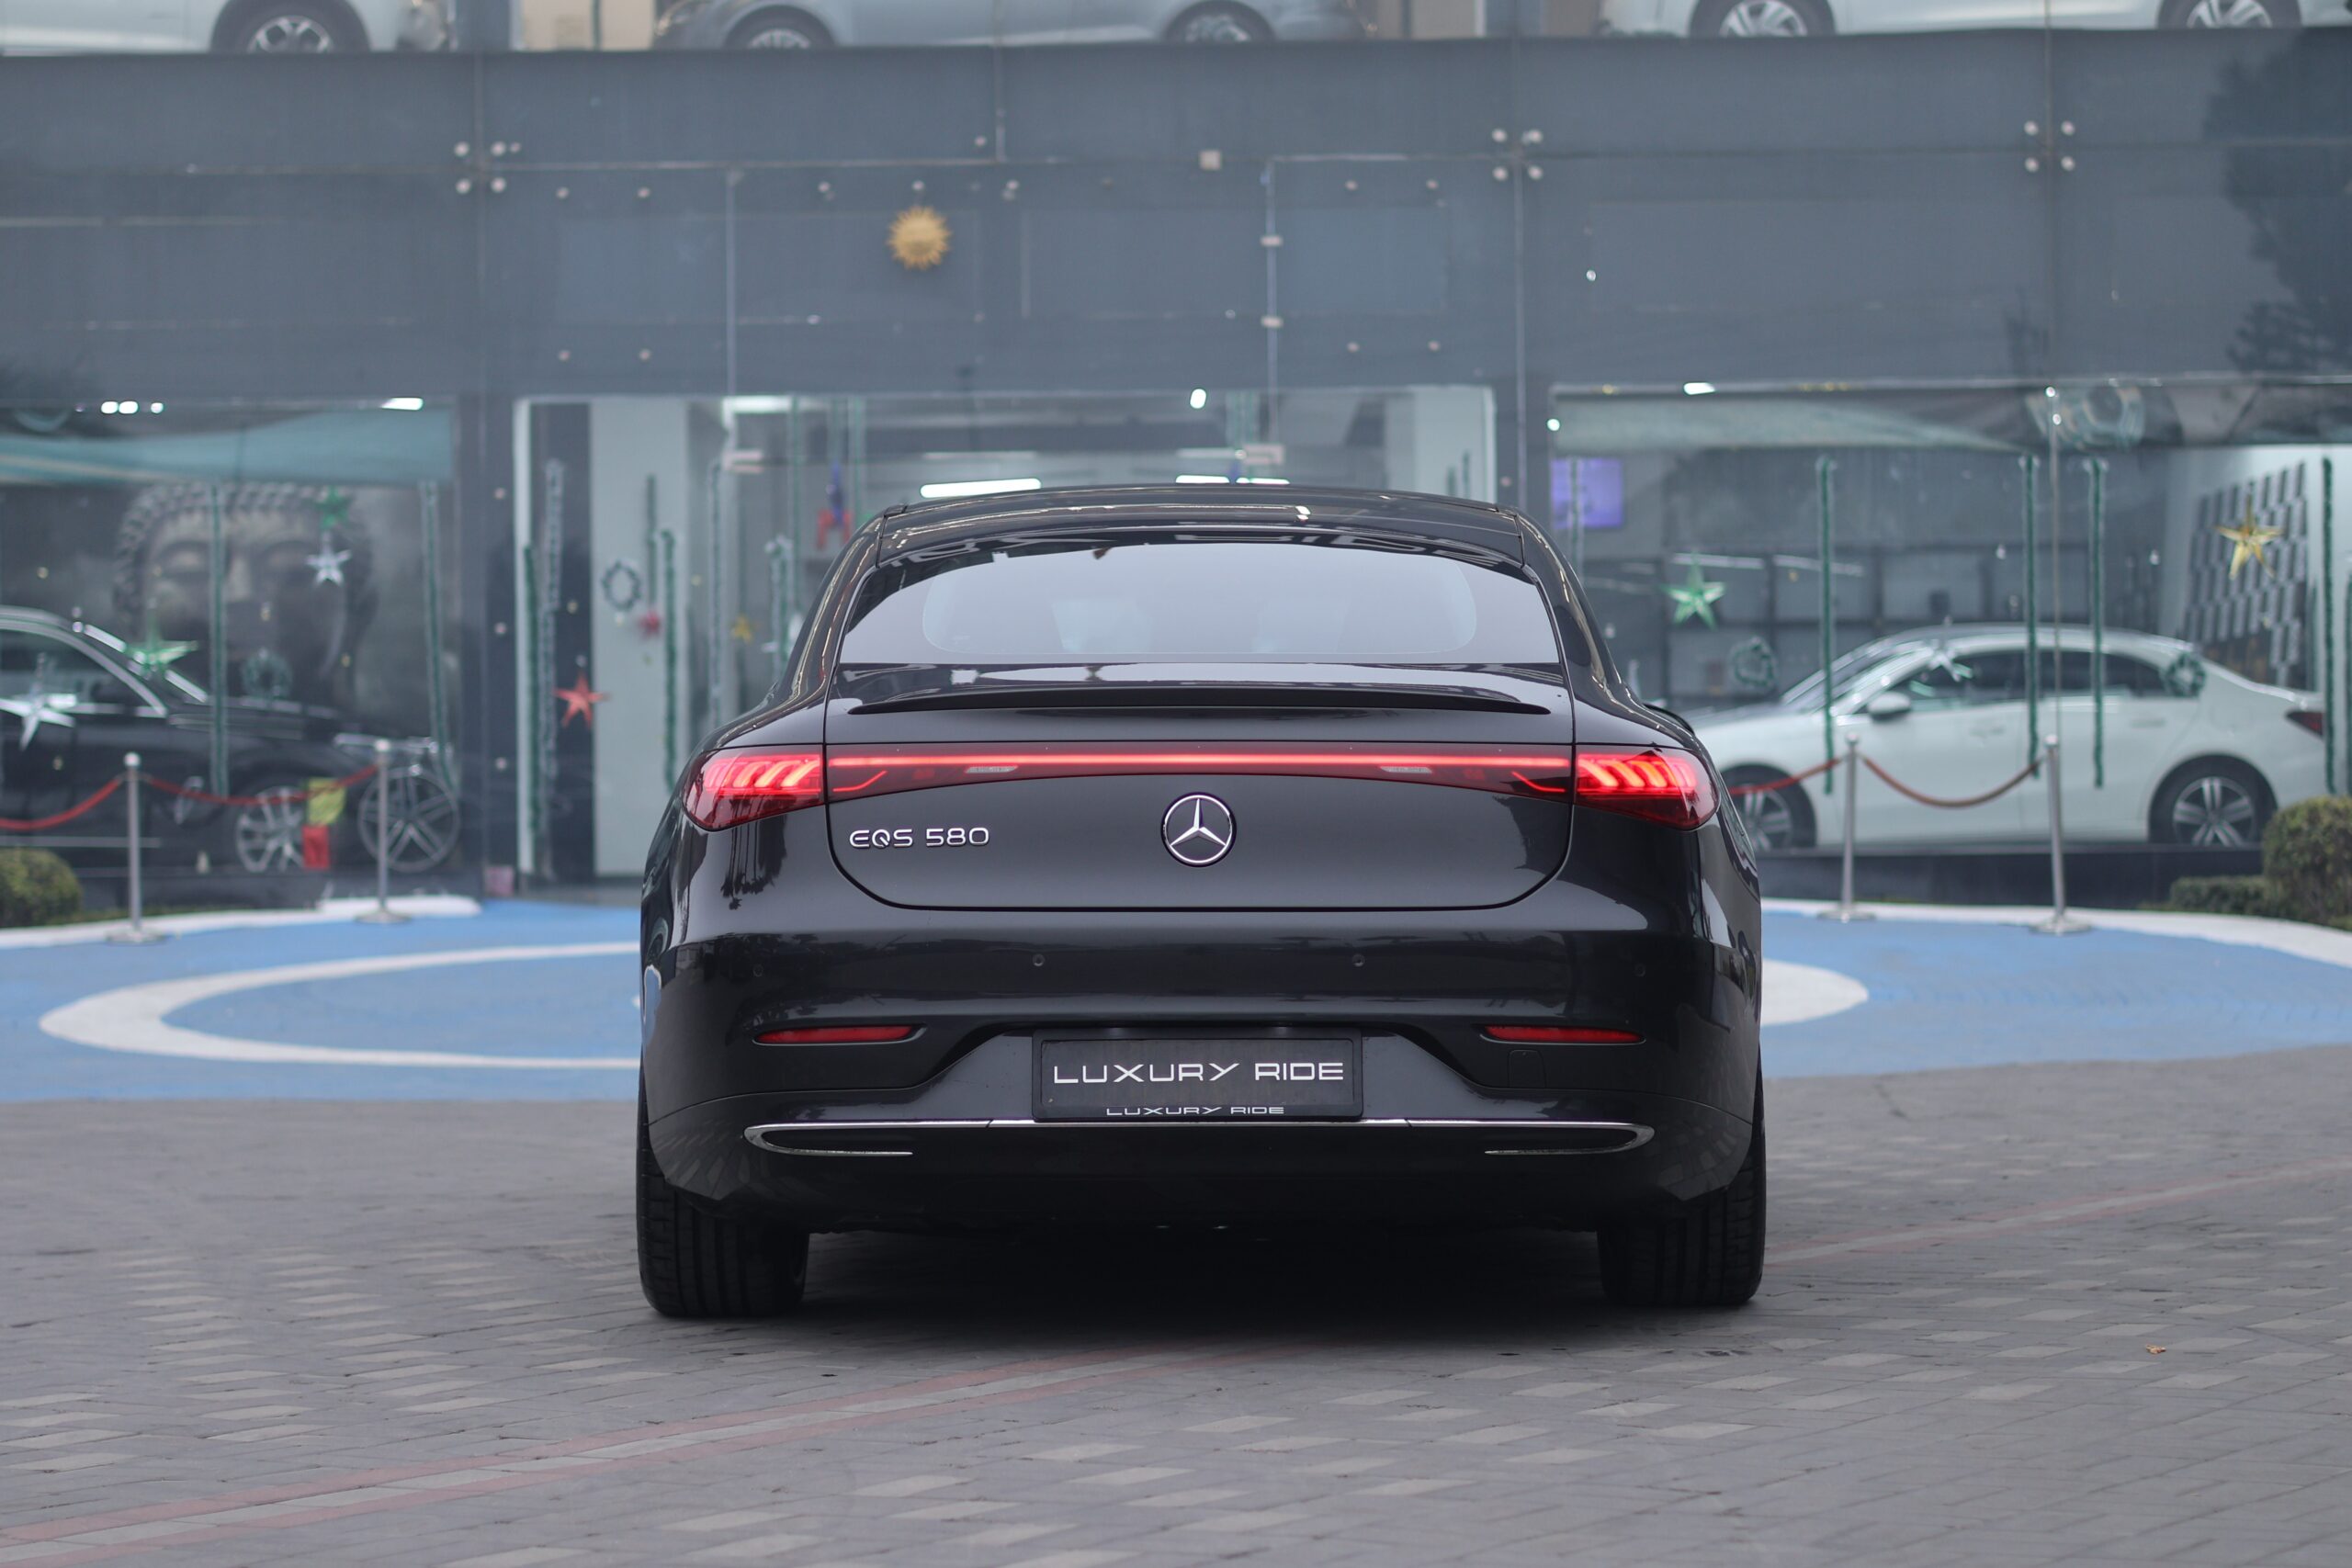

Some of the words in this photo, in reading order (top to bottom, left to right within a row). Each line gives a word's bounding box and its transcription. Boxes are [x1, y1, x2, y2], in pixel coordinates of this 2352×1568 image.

[849, 829, 913, 848] EQS
[925, 827, 989, 846] 580
[1053, 1062, 1240, 1084] LUXURY
[1254, 1062, 1344, 1081] RIDE
[1106, 1106, 1222, 1116] LUXURY
[1230, 1106, 1284, 1114] RIDE
